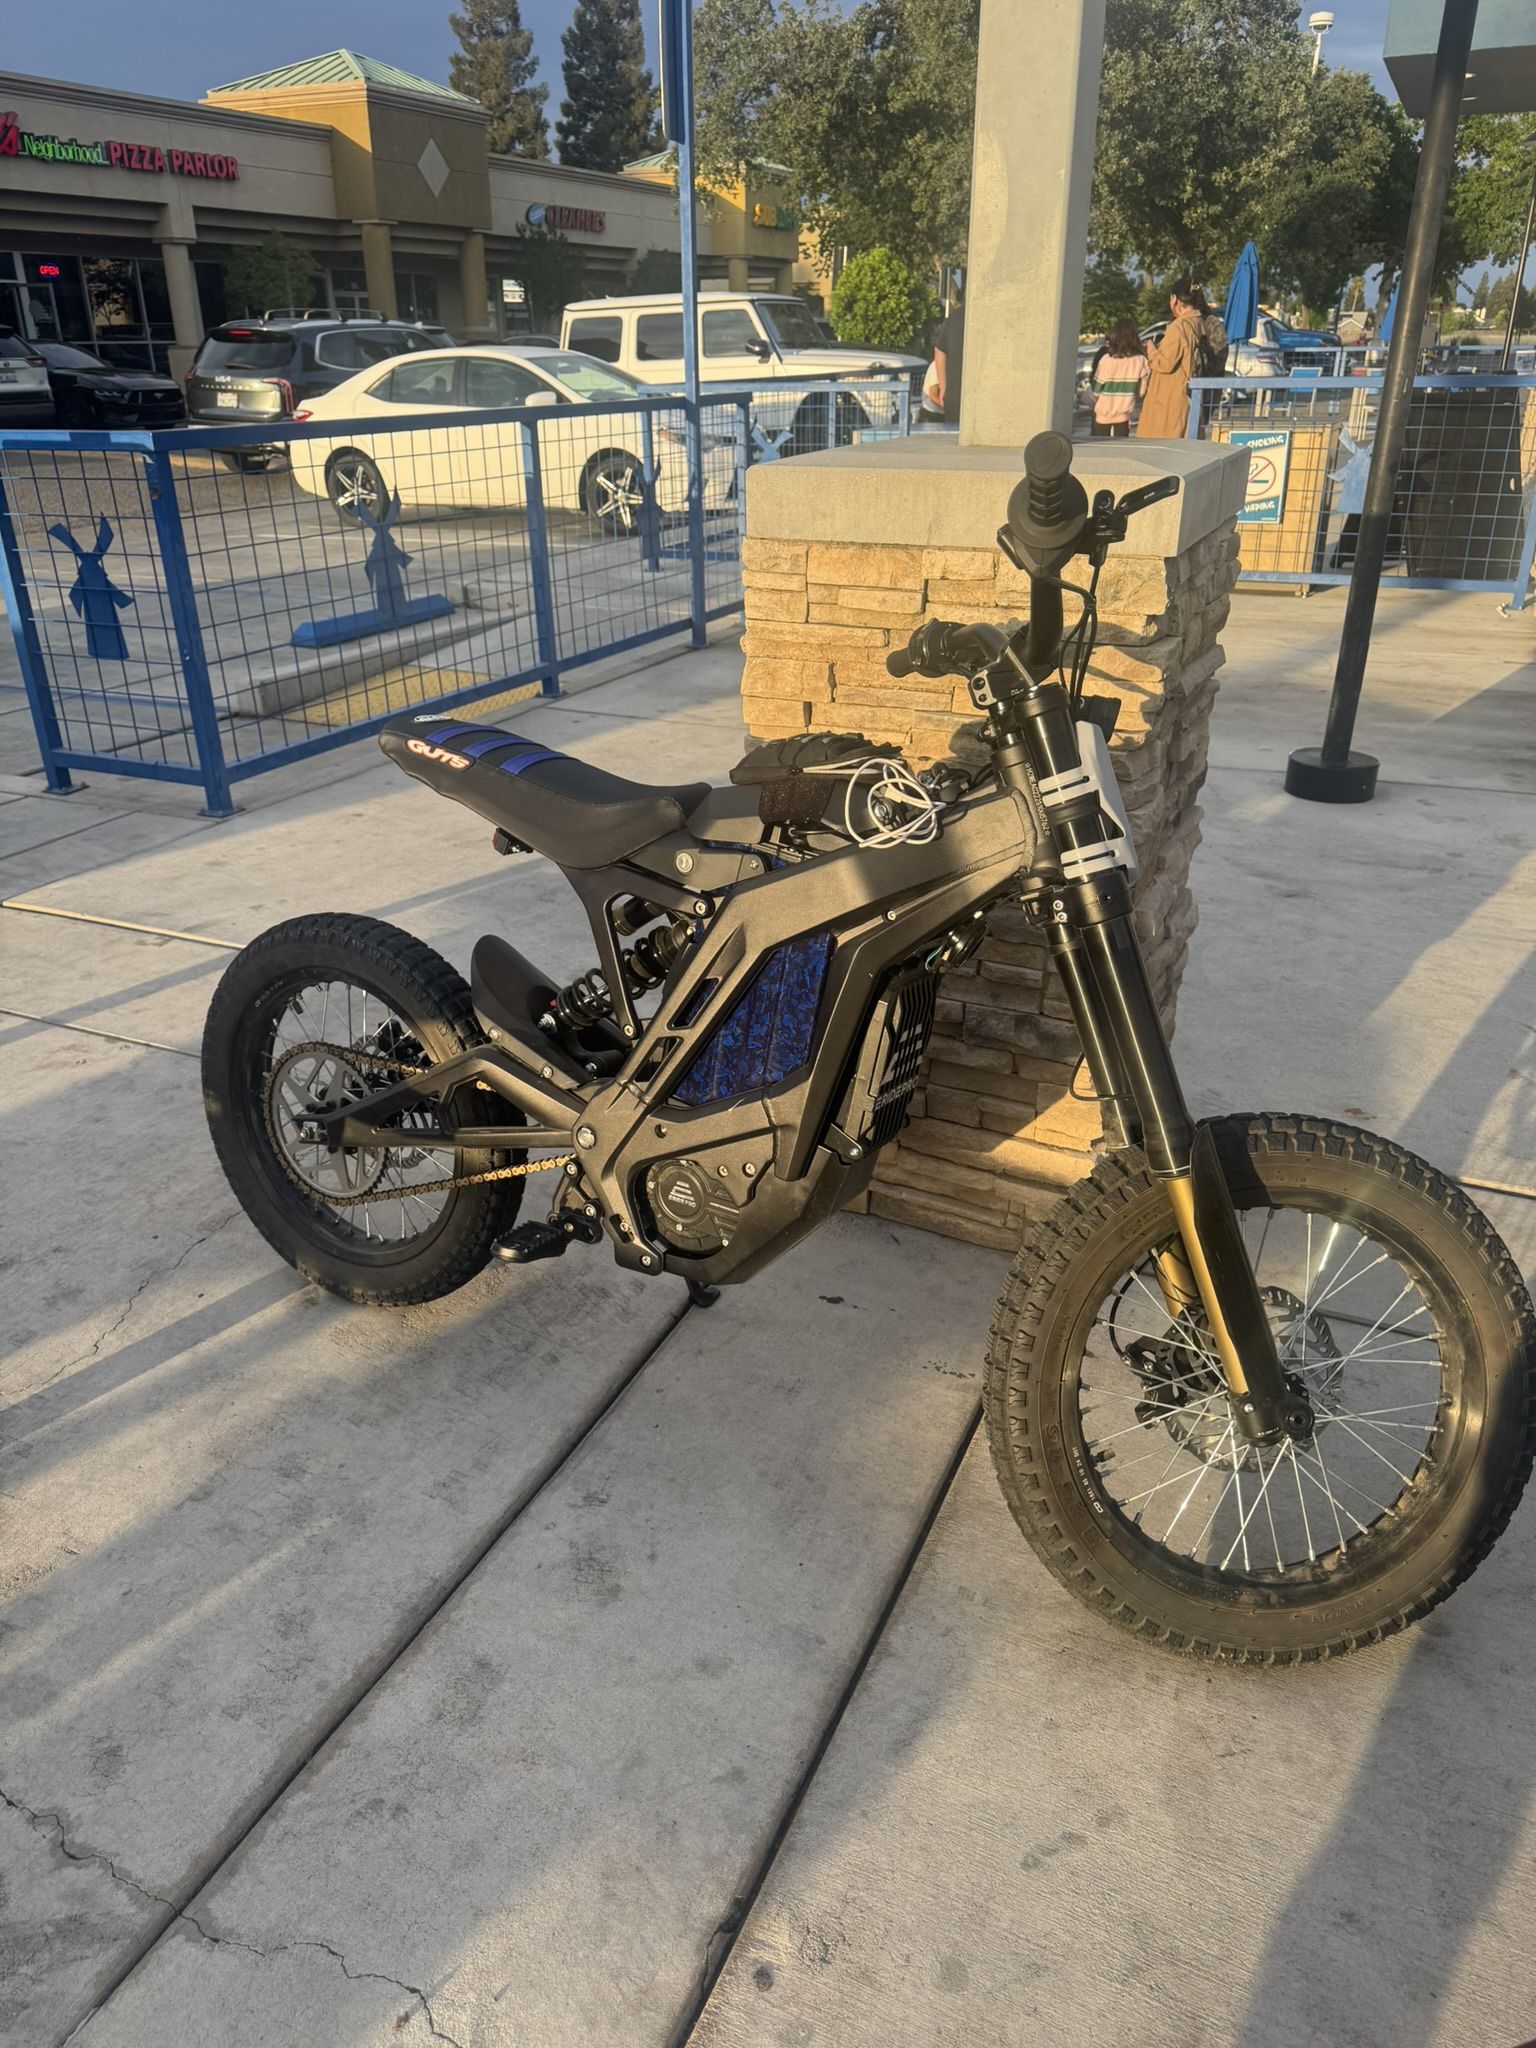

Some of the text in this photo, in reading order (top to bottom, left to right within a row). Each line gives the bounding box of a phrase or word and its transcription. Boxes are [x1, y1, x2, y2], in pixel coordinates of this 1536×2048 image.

[19, 133, 110, 165] Neighborhood
[107, 140, 166, 171] PIZZA
[169, 148, 239, 180] PARLOR
[39, 265, 59, 275] OPEN
[1244, 501, 1275, 513] VAPING
[406, 739, 470, 769] GUTS
